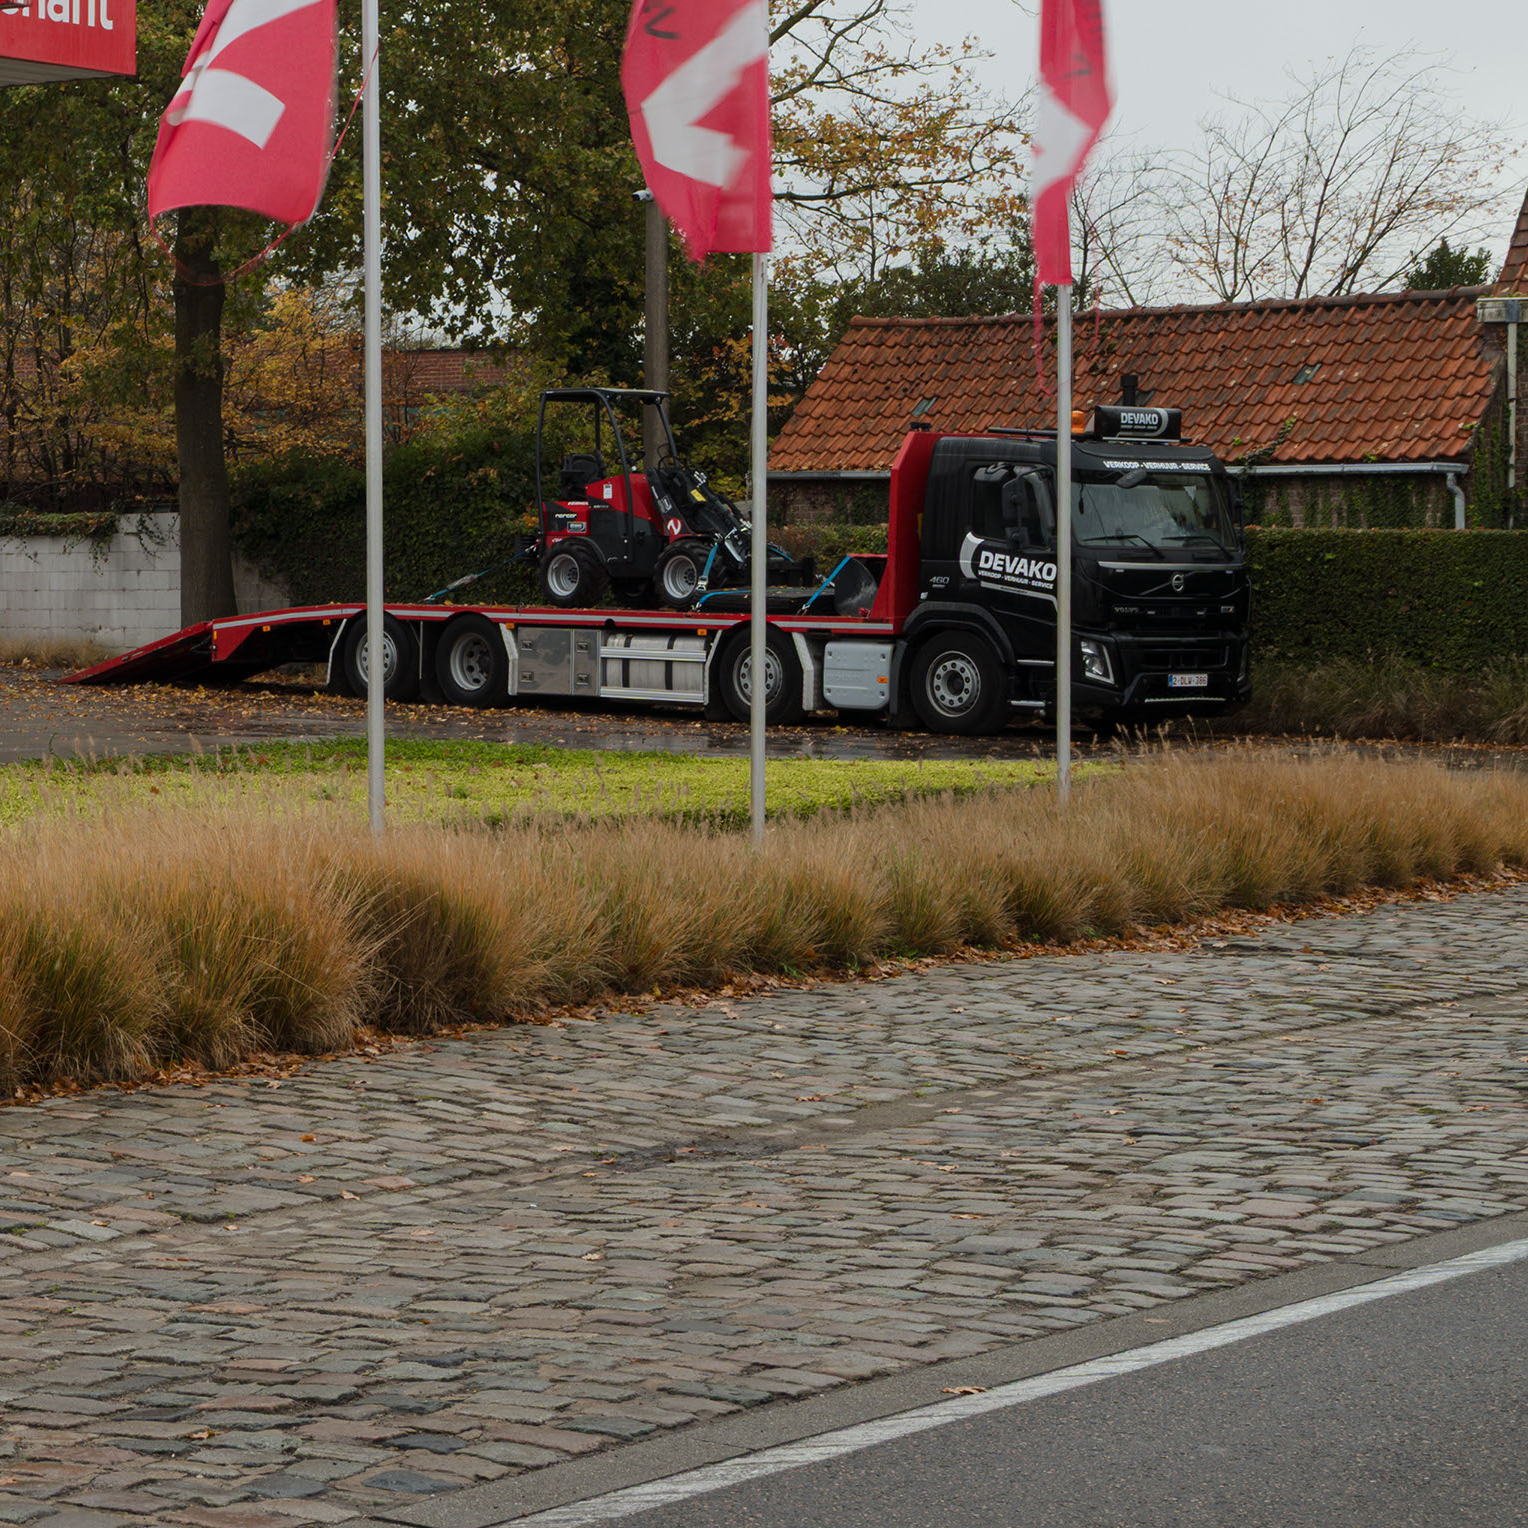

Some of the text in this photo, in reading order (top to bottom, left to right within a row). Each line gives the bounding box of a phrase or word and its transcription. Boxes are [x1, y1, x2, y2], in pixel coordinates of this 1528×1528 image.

[1120, 412, 1159, 425] DEVAKO
[1103, 460, 1140, 470] VERKOOP
[1143, 461, 1179, 470] VERHUUR
[1181, 462, 1212, 471] SERVICE
[978, 550, 1058, 582] DEVAKO
[929, 576, 950, 584] 460
[978, 569, 1002, 580] VERKOOP
[1004, 574, 1029, 585] VERHUUR
[1031, 579, 1054, 590] SERVICE
